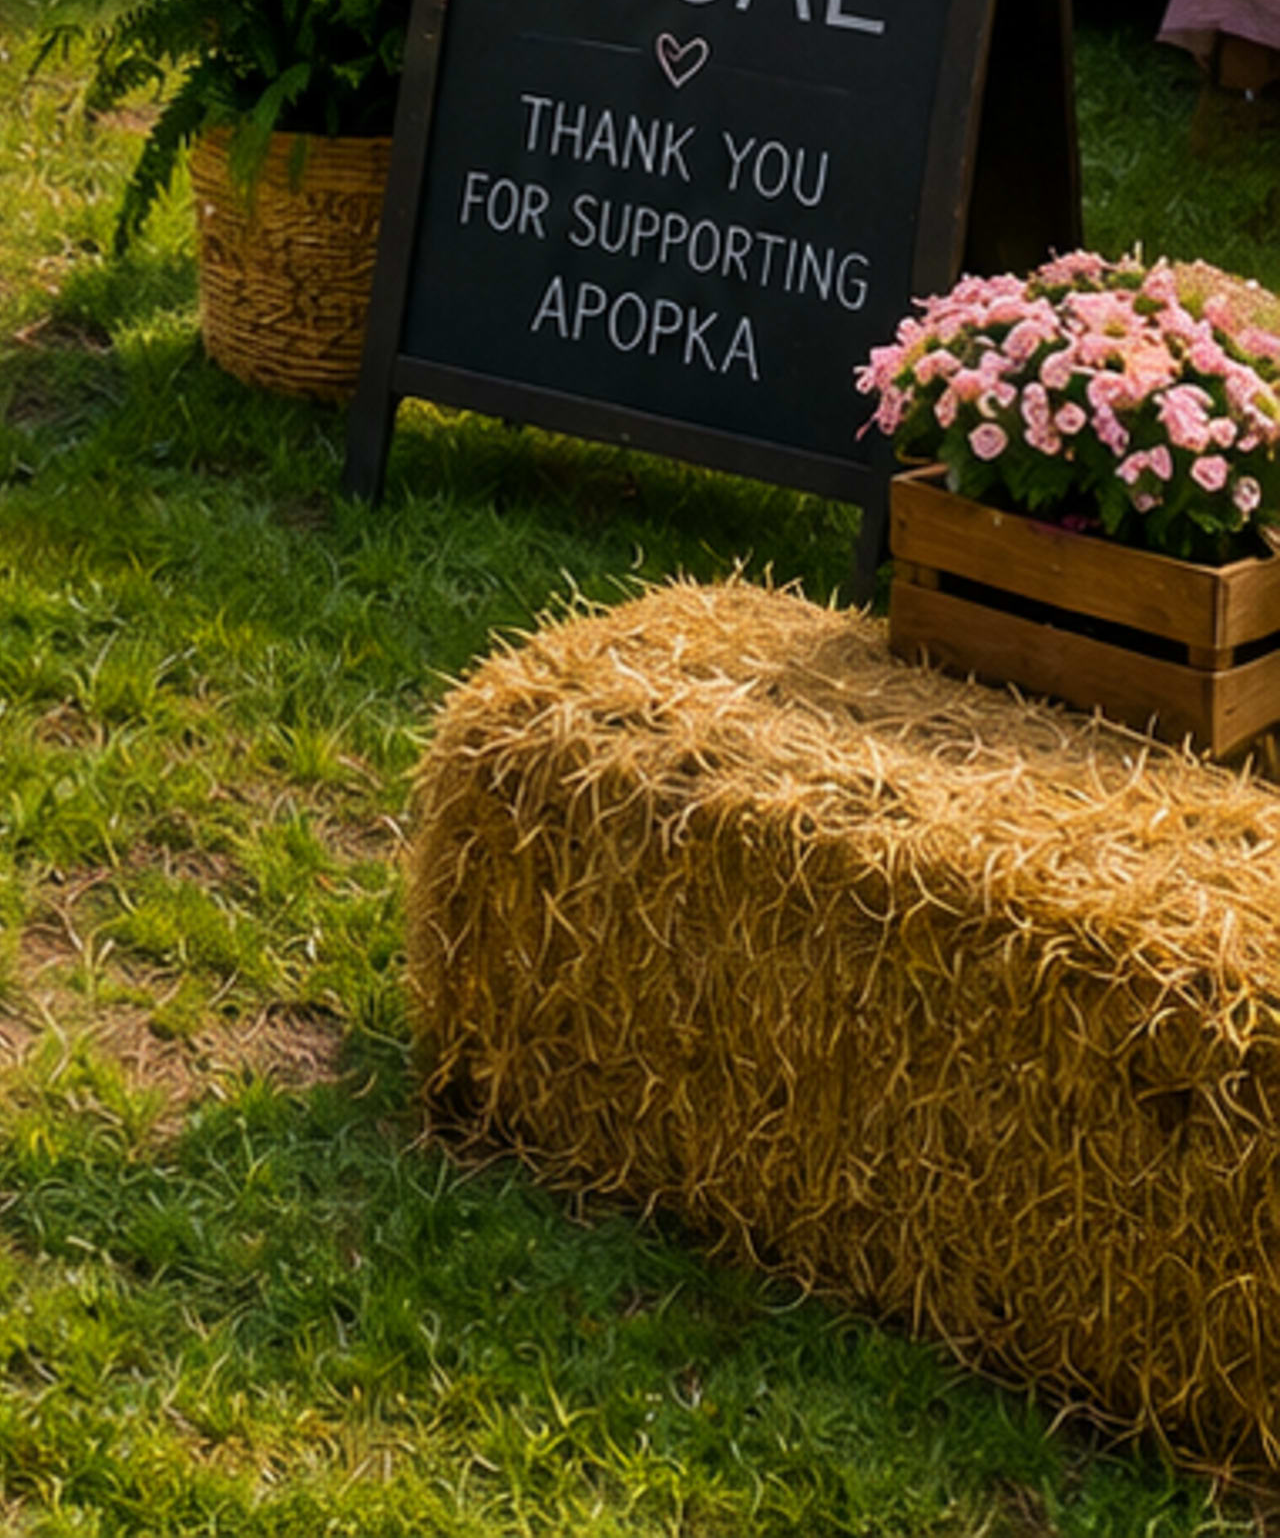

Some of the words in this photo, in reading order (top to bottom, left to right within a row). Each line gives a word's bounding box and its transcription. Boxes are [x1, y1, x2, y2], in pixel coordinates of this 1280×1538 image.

[522, 95, 694, 181] THANK
[724, 133, 828, 206] YOU
[461, 172, 549, 238] FOR
[570, 195, 868, 309] SUPPORTING
[532, 277, 758, 380] APOPKA
